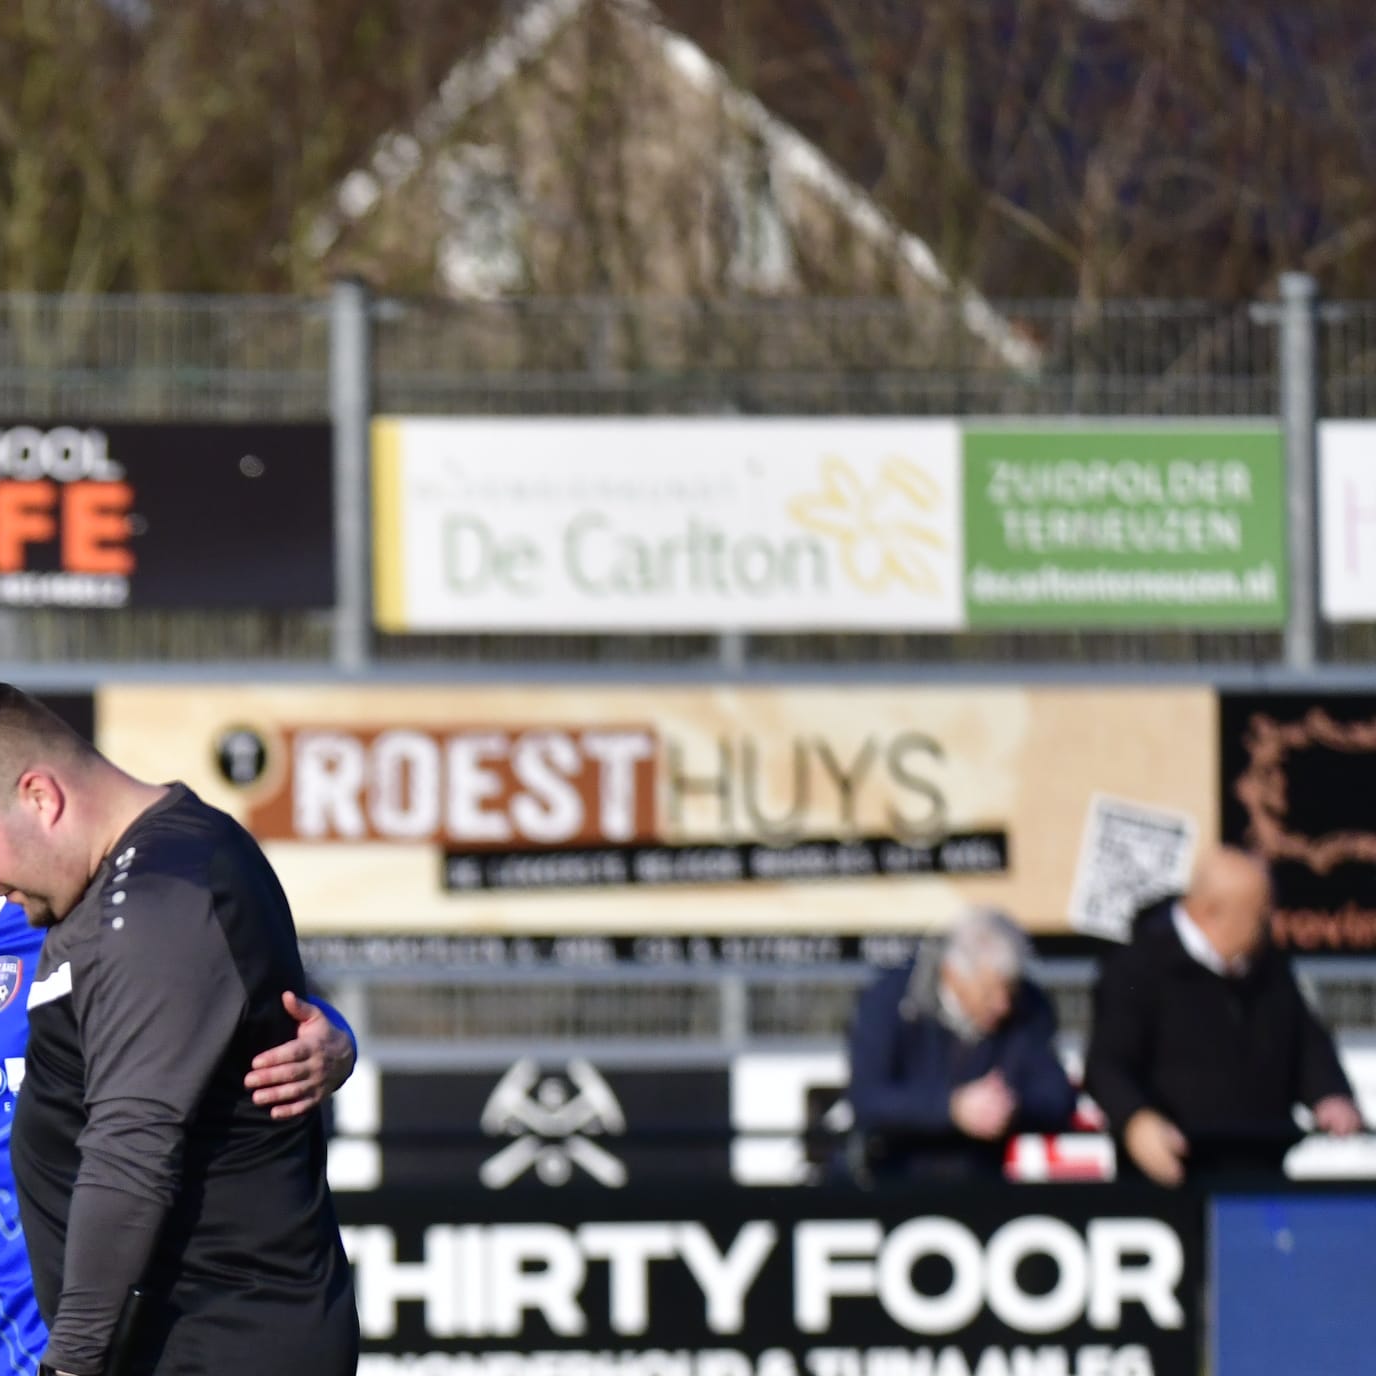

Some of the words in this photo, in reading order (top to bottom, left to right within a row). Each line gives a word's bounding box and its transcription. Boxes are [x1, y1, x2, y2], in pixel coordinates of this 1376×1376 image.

[988, 460, 1252, 504] ZUIDPOLDER
[440, 511, 542, 596] De
[563, 510, 829, 597] Carlton
[1002, 508, 1242, 552] TERNEUZEN
[340, 1221, 778, 1338] HIRTY
[793, 1215, 1185, 1335] FOOR
